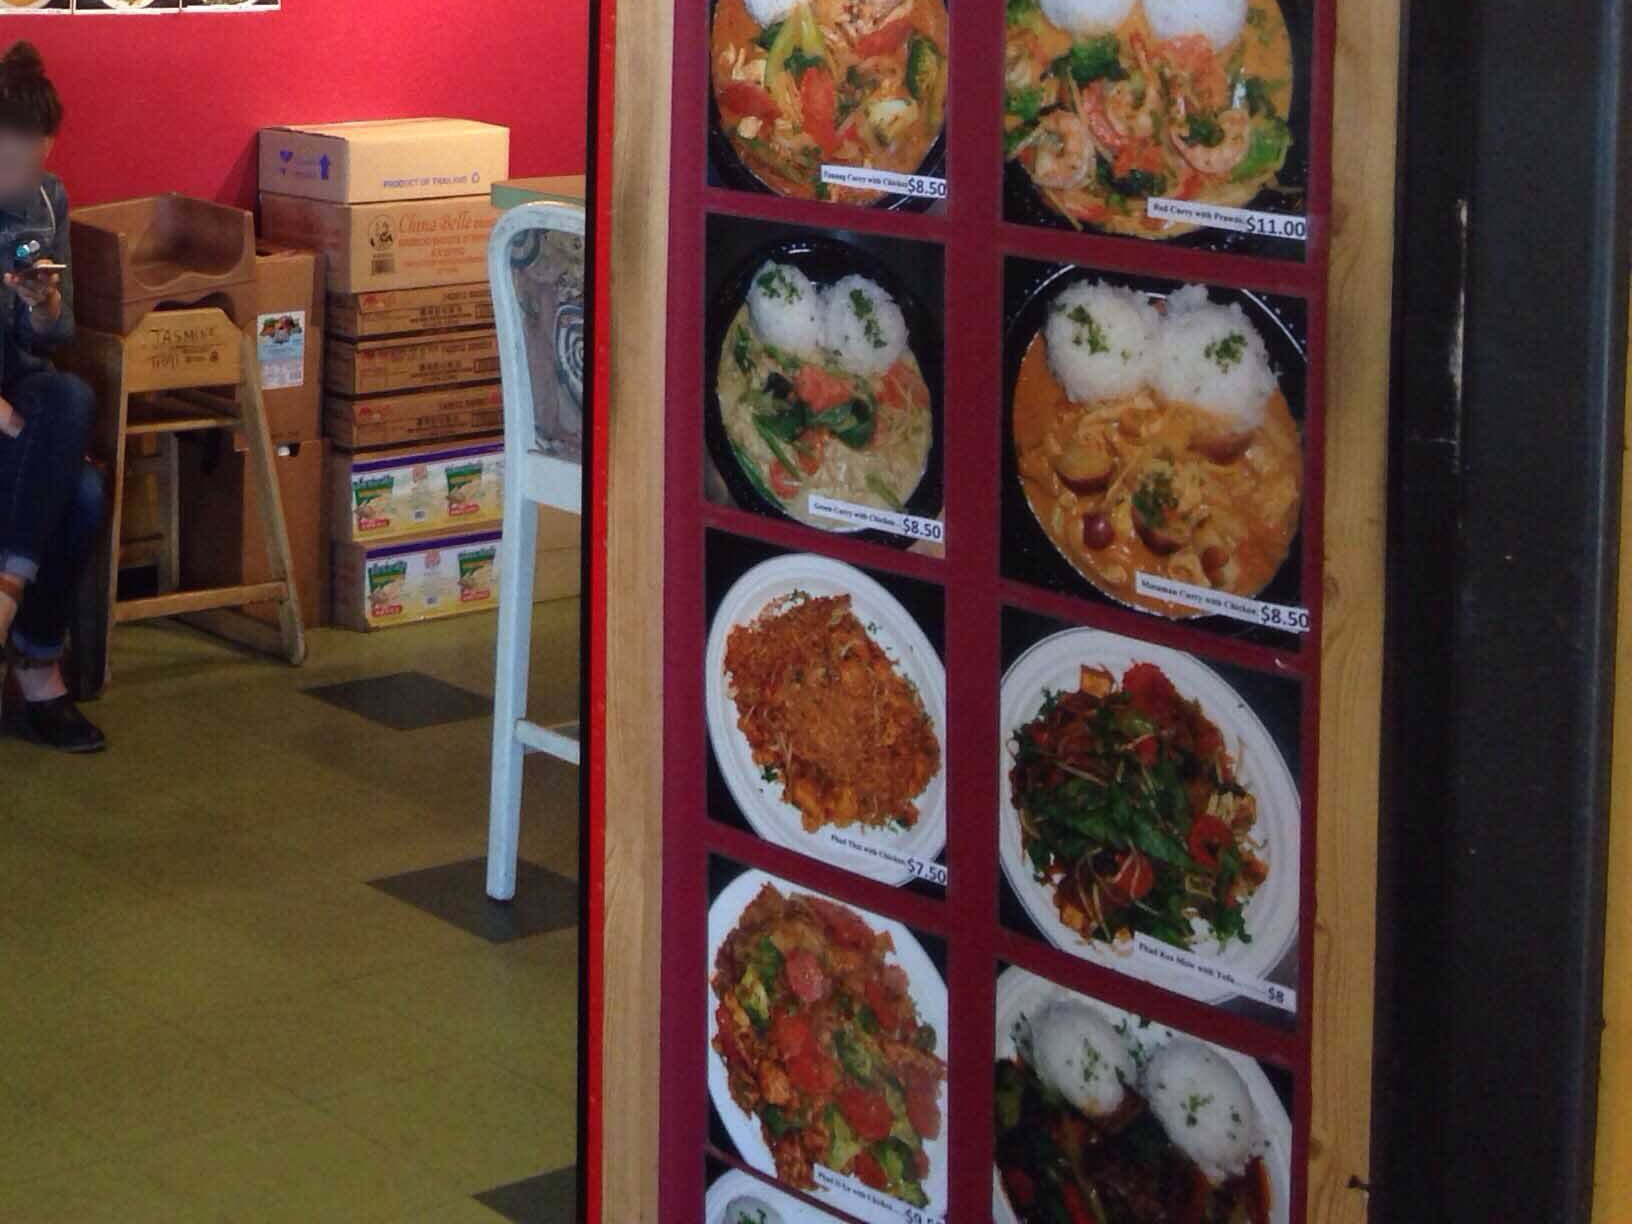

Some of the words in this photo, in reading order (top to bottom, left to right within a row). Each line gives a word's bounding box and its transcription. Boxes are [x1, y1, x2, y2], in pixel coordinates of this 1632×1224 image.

[383, 177, 418, 188] PRODUCT
[908, 177, 946, 196] $8.50
[1170, 205, 1193, 217] Curry
[1195, 210, 1212, 219] with
[1246, 215, 1306, 236] $11.00
[903, 517, 941, 539] $8.50
[1179, 590, 1203, 604] Curry
[1205, 597, 1222, 608] with
[1223, 600, 1257, 615] Chicken
[1260, 604, 1309, 628] $8.50
[907, 857, 946, 883] $7.50
[1138, 942, 1158, 956] Phad
[1267, 987, 1285, 1004] $8
